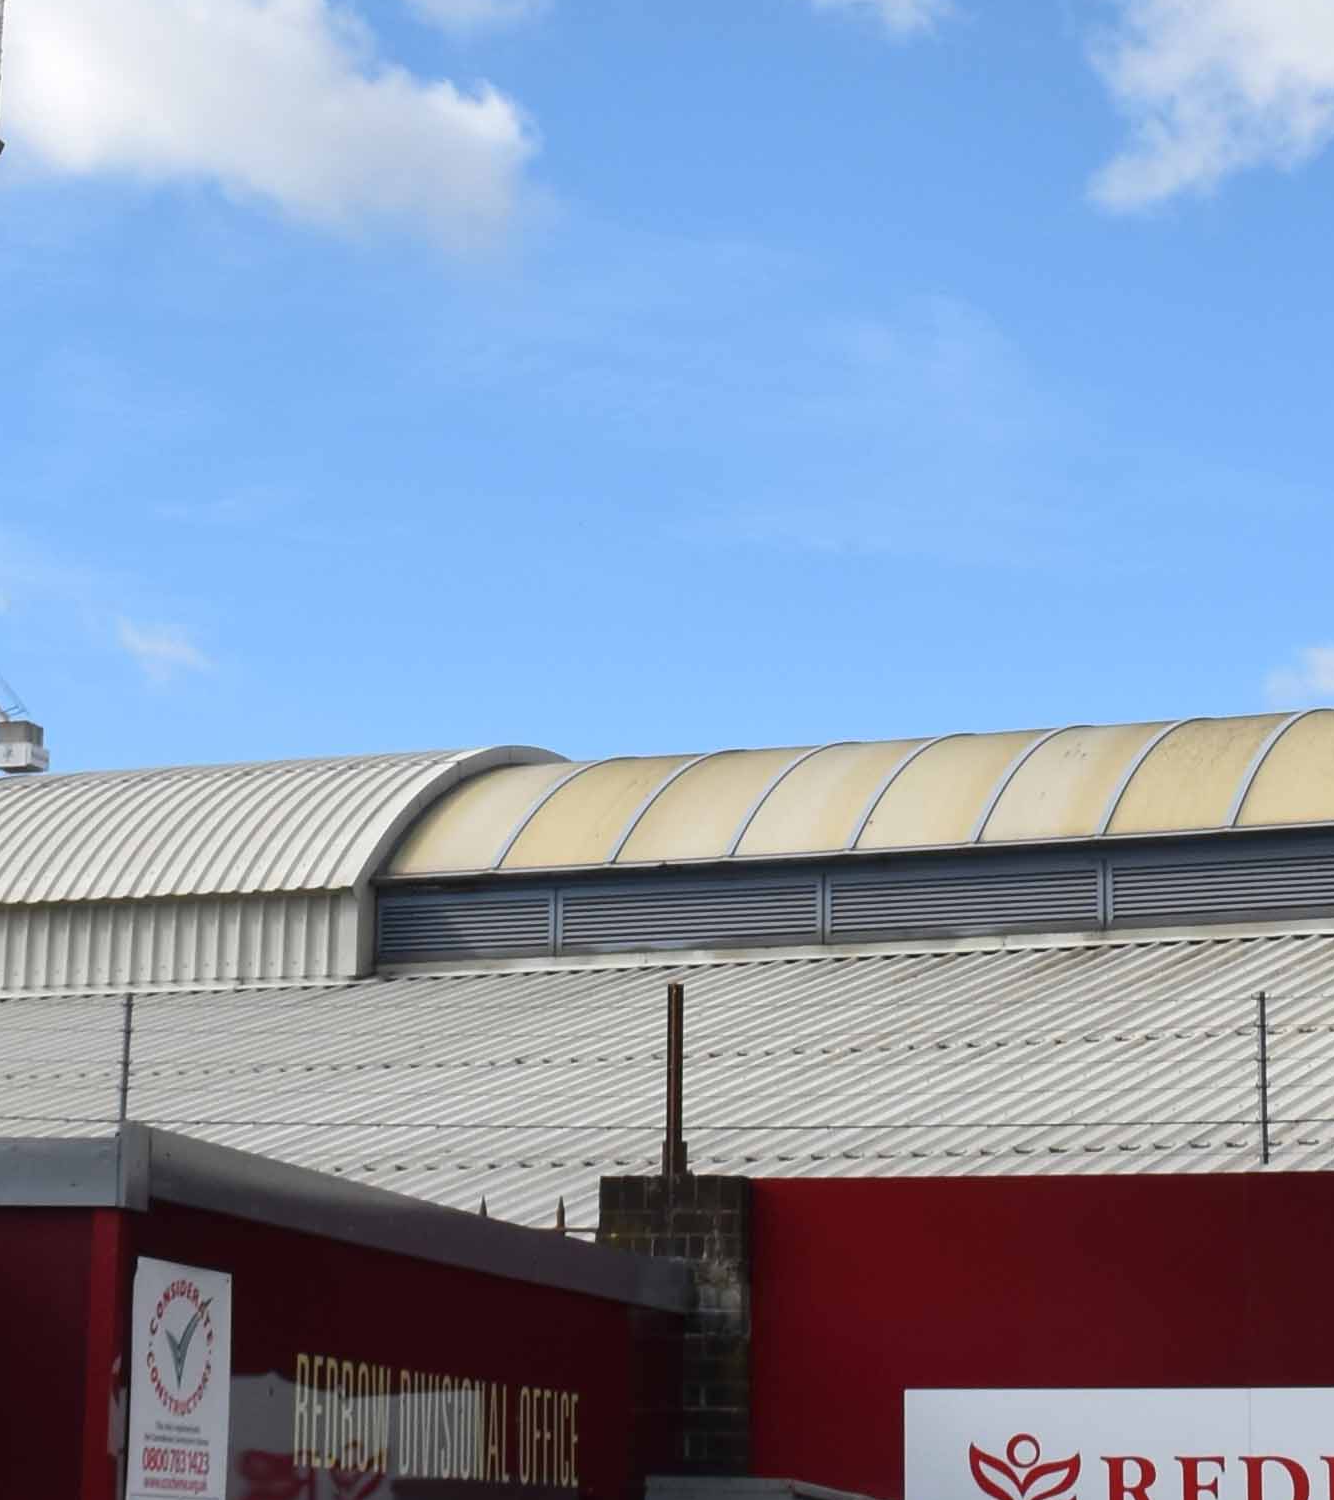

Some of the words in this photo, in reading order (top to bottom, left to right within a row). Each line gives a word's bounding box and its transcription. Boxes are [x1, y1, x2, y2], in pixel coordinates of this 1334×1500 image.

[293, 1353, 391, 1473] REDROW
[399, 1369, 510, 1483] DIVISIONAL
[518, 1386, 579, 1488] OFFICE
